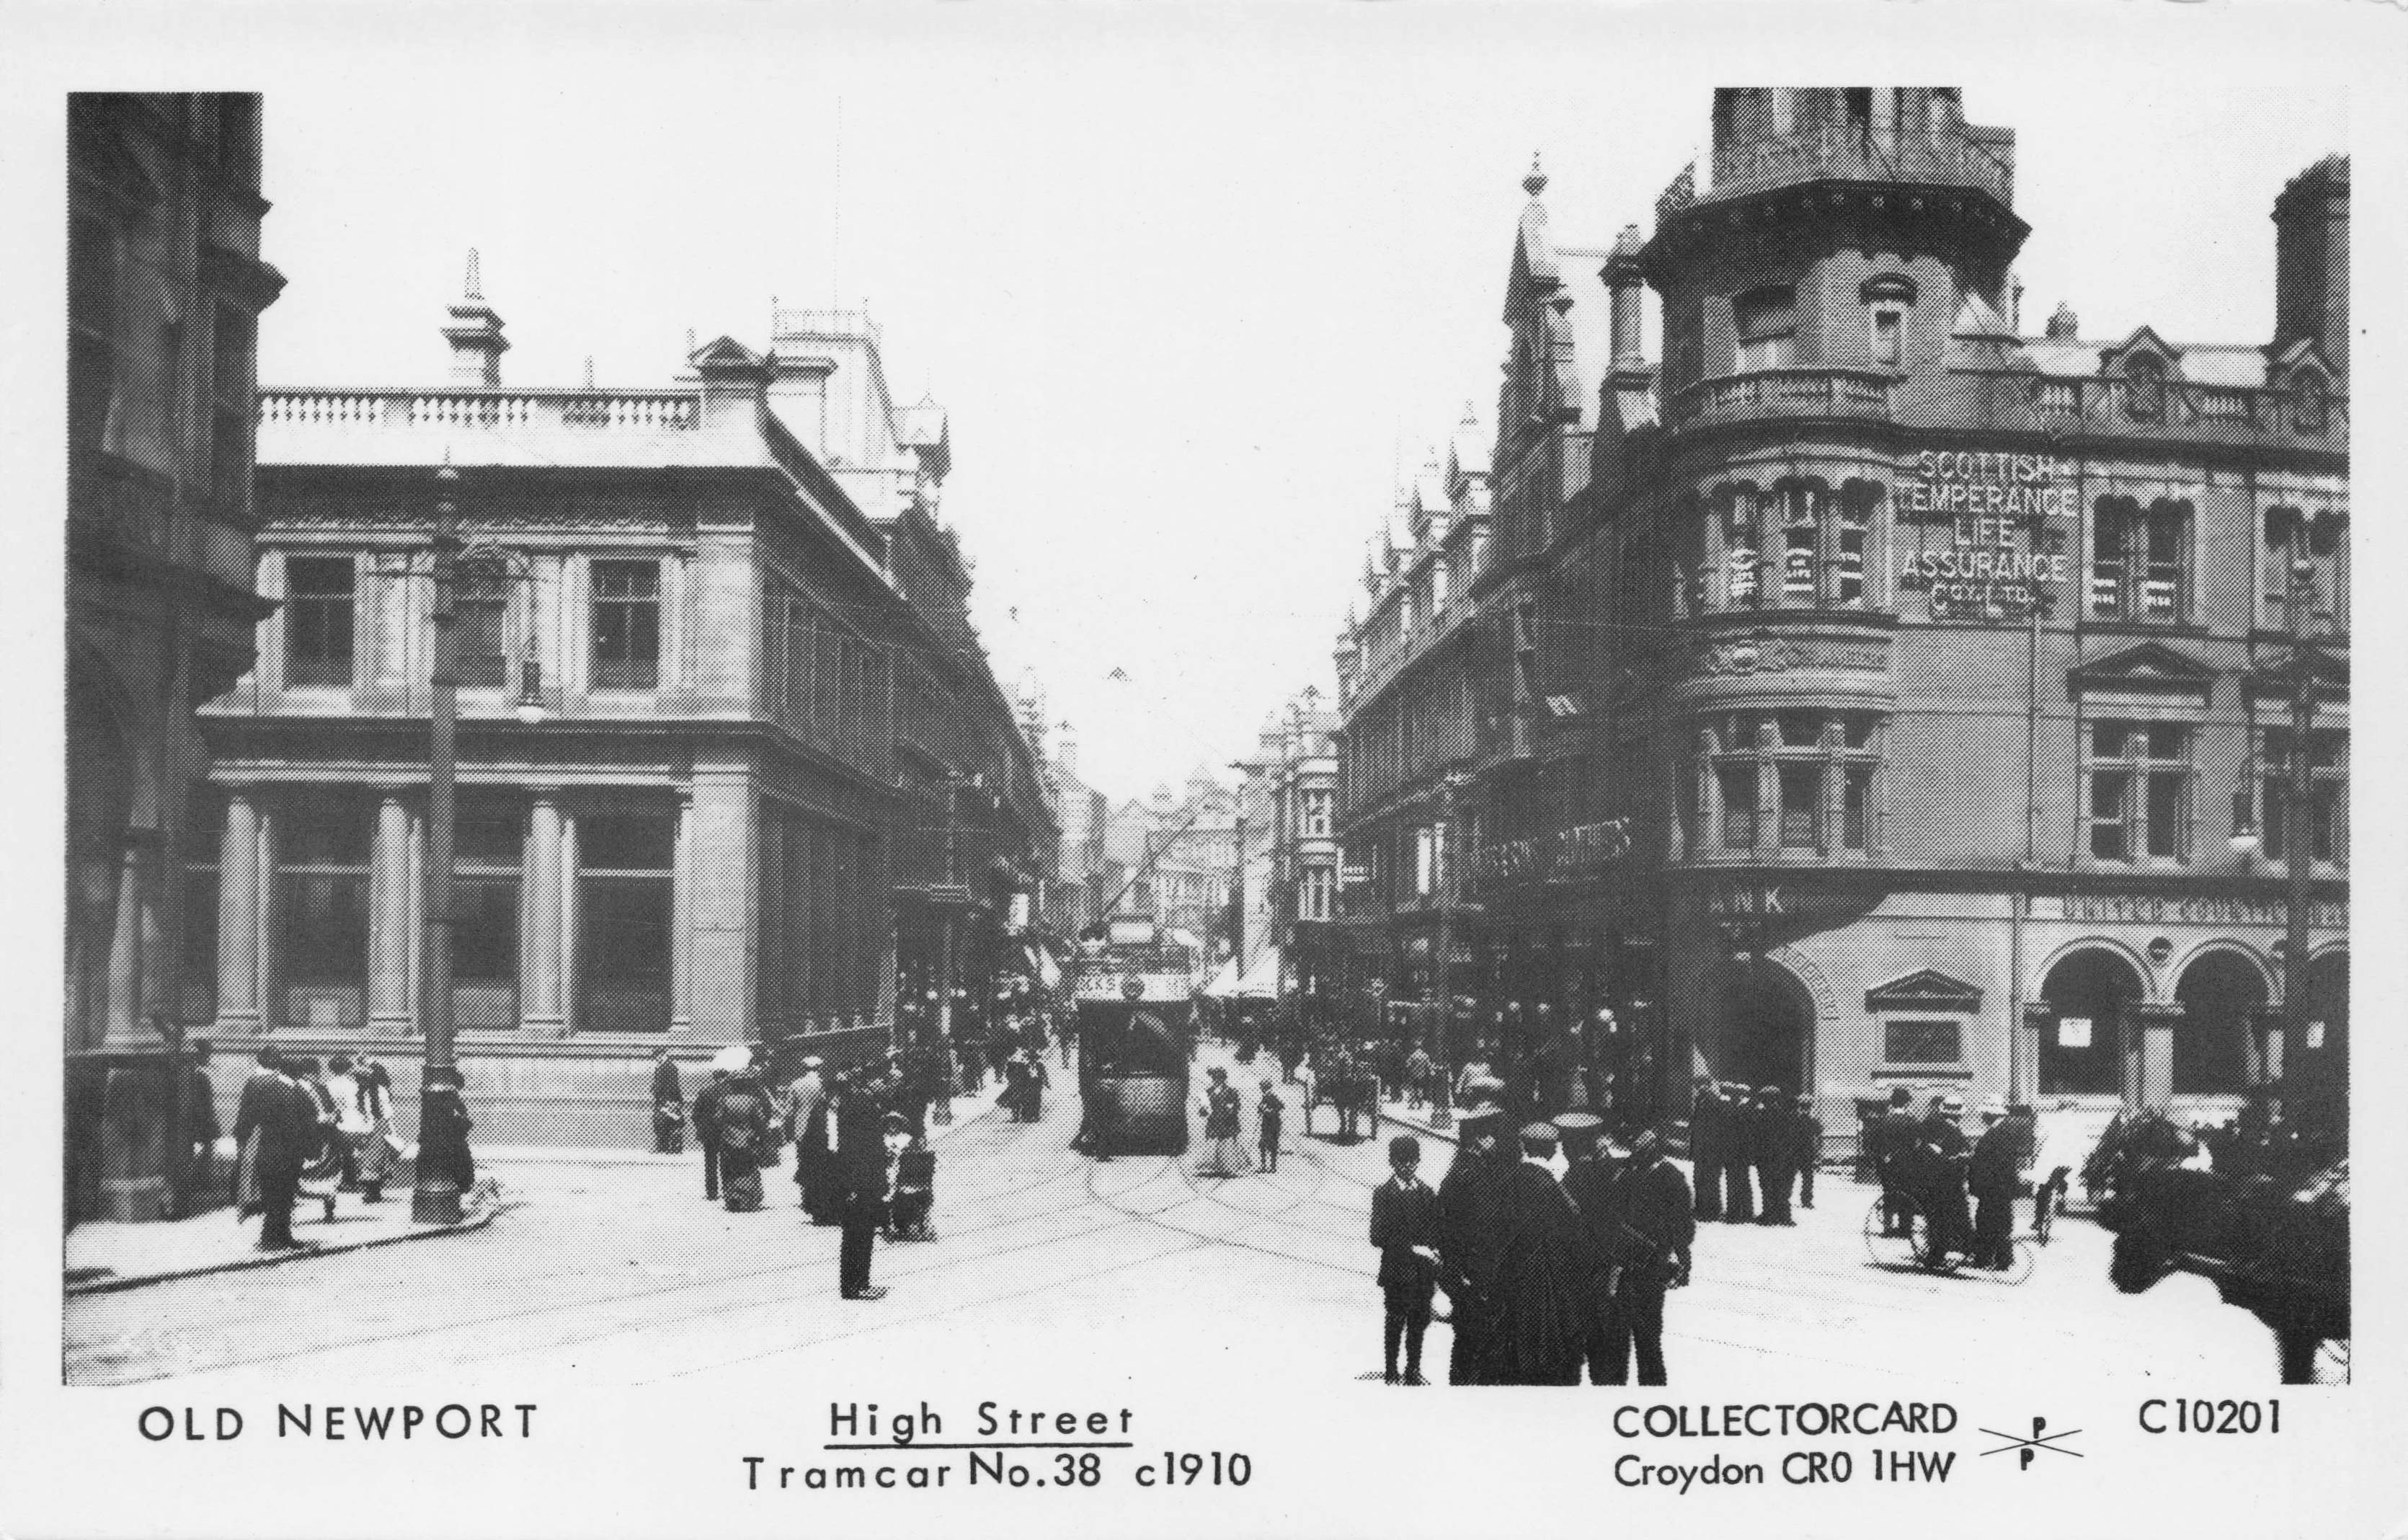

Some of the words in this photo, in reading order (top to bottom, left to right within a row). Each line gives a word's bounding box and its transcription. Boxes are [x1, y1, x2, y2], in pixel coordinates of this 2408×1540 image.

[1919, 450, 2054, 482] SCOTTISH
[1895, 481, 2078, 518] TEMPERANCE
[1955, 518, 2016, 547] LIFE
[1901, 549, 2068, 583] ASSURANCE
